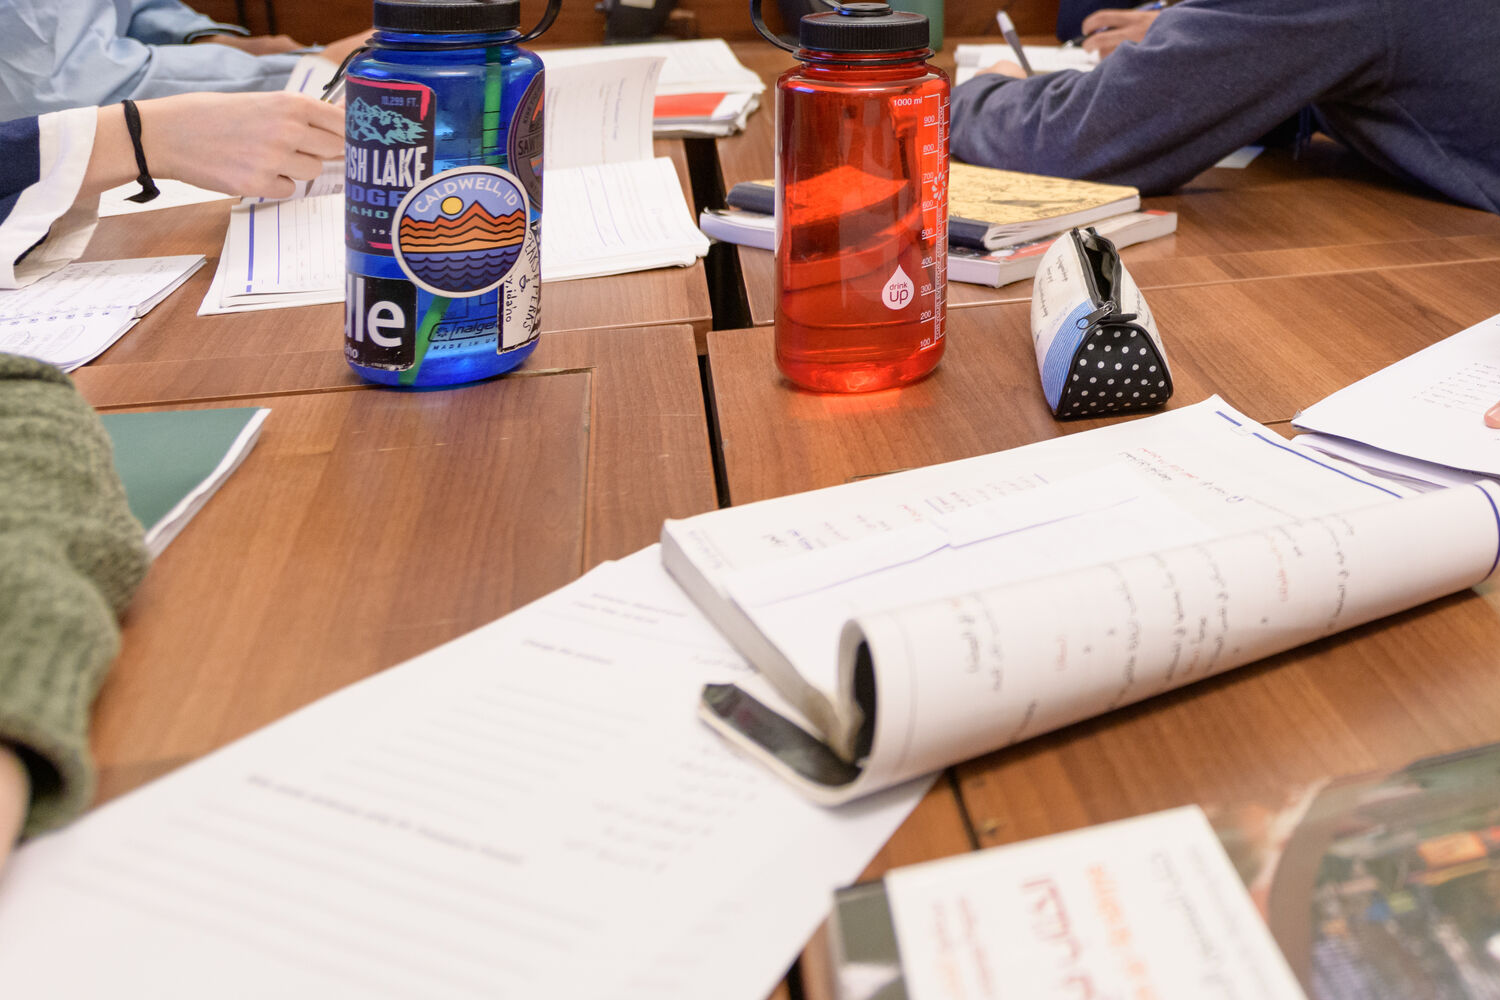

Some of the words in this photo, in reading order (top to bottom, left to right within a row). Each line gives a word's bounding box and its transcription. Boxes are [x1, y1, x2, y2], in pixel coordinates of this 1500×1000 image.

[894, 97, 912, 106] 1000
[913, 96, 923, 105] ml
[923, 115, 935, 123] 900
[923, 144, 934, 152] 800
[372, 145, 429, 188] LAKE
[923, 172, 934, 180] 700
[414, 177, 502, 214] CALDWELL,
[503, 190, 519, 207] ID
[922, 200, 933, 208] 600
[922, 228, 933, 237] 500
[921, 256, 932, 266] 400
[889, 281, 908, 291] drink
[921, 284, 931, 293] 300
[889, 289, 909, 305] up
[921, 311, 931, 320] 200
[920, 338, 930, 348] 100
